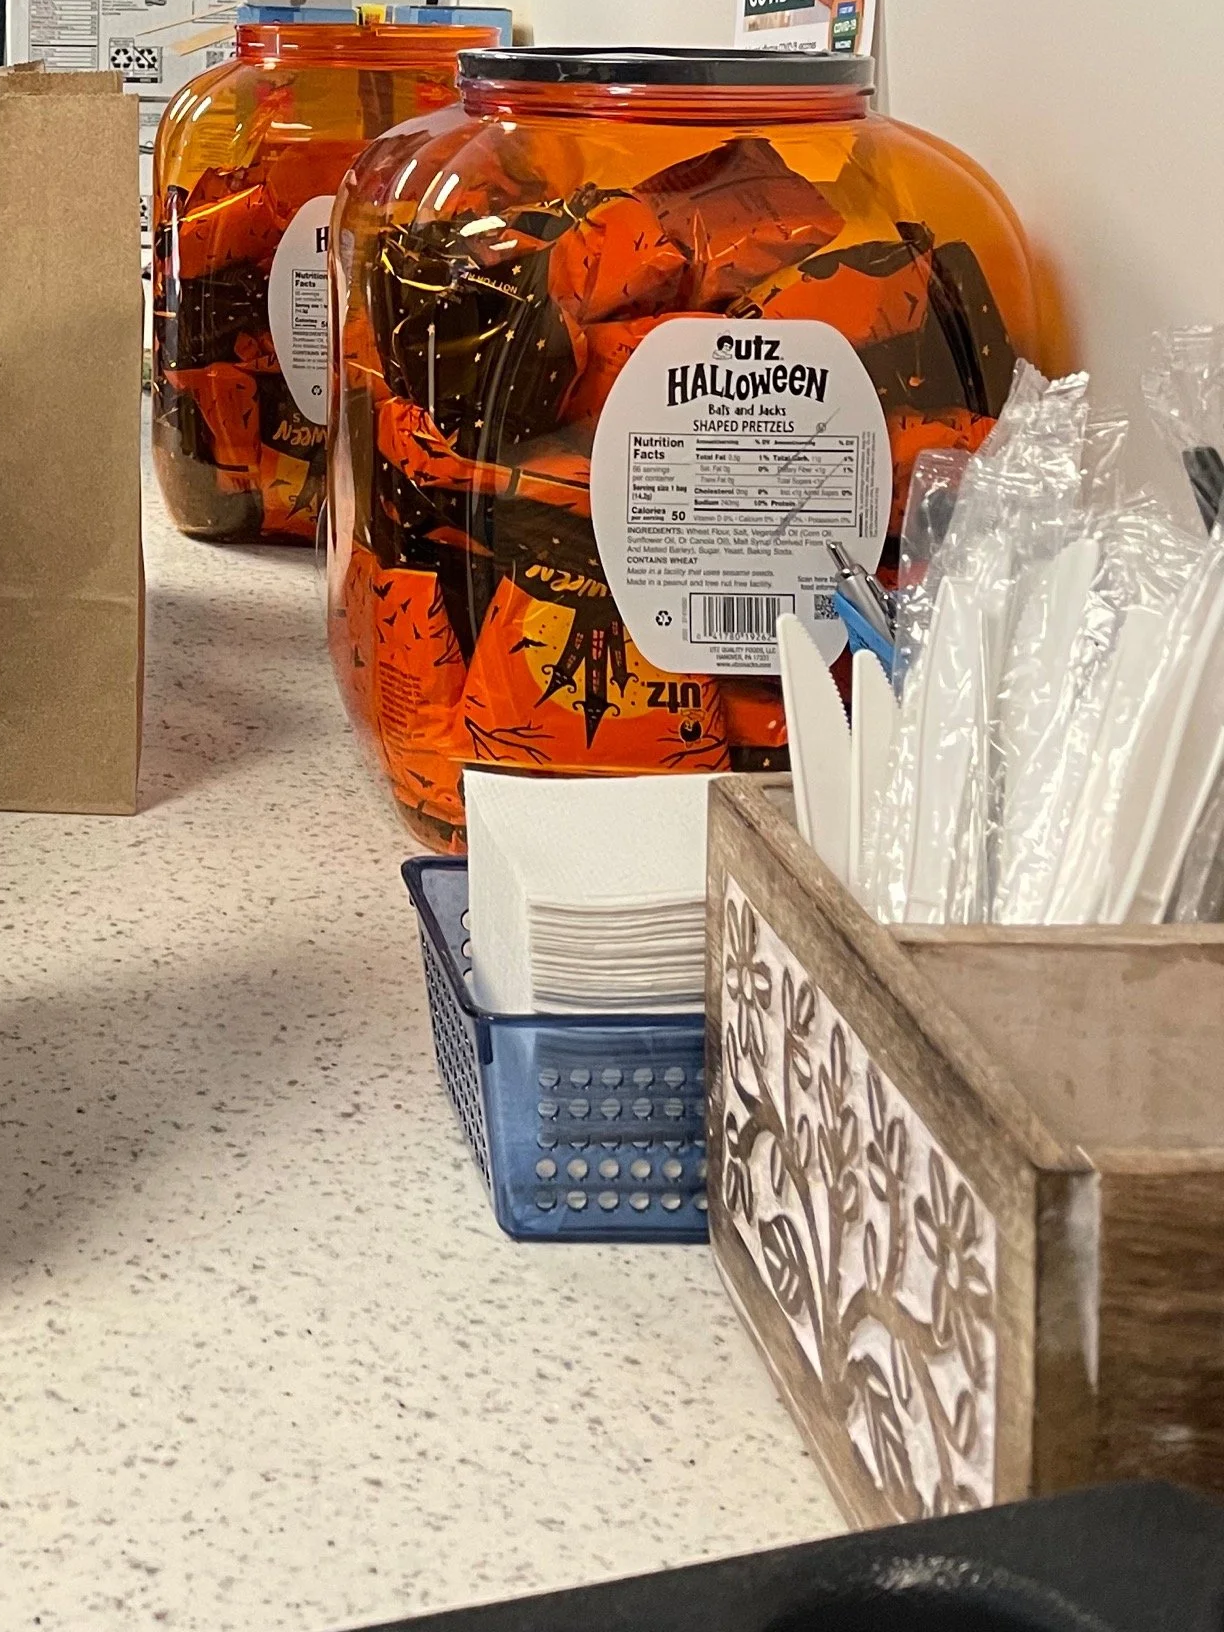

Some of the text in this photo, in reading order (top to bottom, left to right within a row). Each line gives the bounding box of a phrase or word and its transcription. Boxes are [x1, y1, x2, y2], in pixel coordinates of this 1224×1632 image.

[294, 280, 316, 288] Facts
[498, 282, 518, 294] NOT
[734, 335, 780, 360] utz
[708, 404, 786, 416] Bats and Jacks
[693, 419, 794, 432] SHAPED PRETZELS
[634, 436, 684, 448] Nutrition
[634, 449, 665, 460] Facts
[633, 484, 655, 492] Serving
[632, 506, 686, 521] Calories 50
[627, 536, 662, 544] Sunflower
[747, 548, 771, 556] Baking
[647, 682, 701, 714] utz
